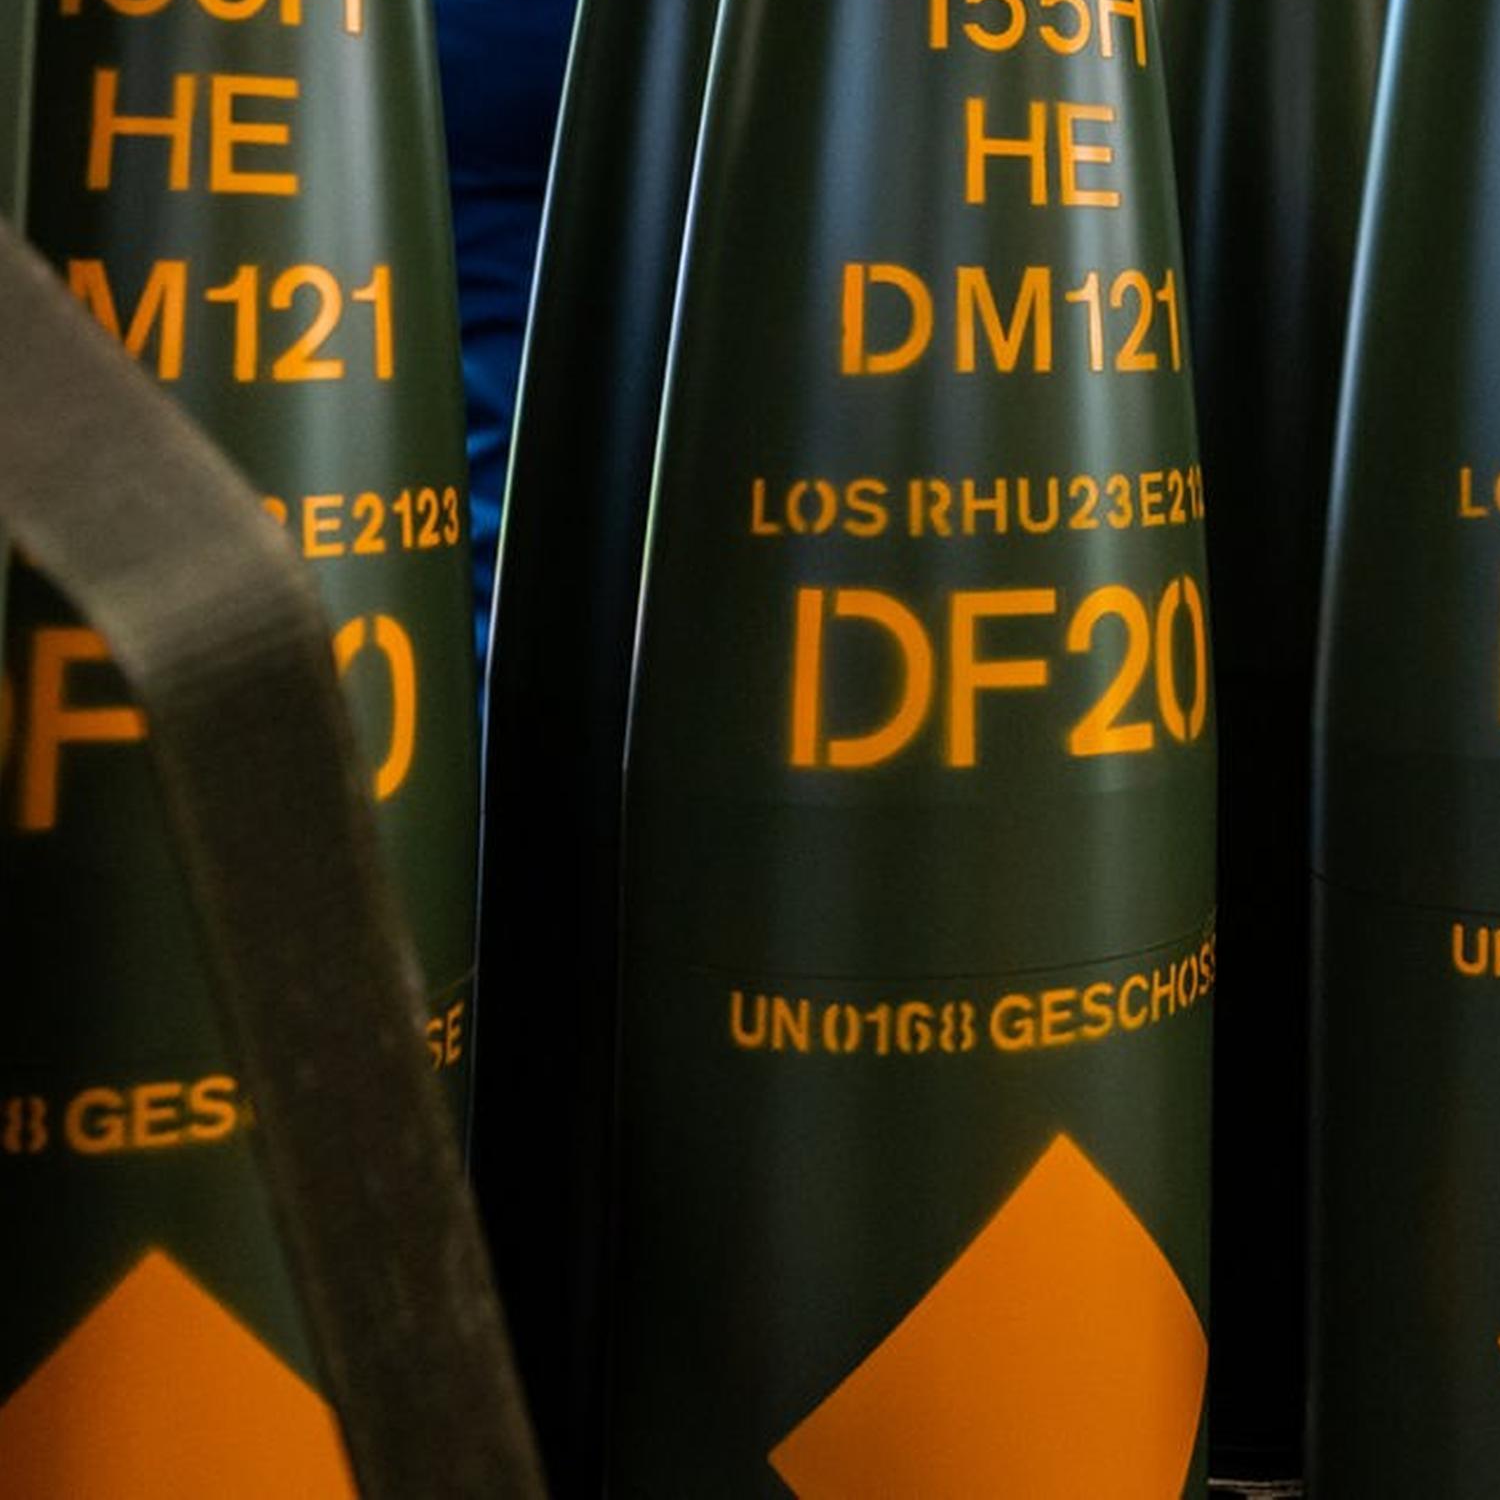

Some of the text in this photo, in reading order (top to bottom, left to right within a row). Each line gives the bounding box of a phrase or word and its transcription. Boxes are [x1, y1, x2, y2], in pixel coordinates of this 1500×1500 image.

[88, 68, 299, 194] HE
[966, 98, 1120, 207] HE
[66, 258, 393, 383] M121
[840, 263, 1181, 375] DM121
[258, 487, 459, 558] E2123
[750, 476, 890, 536] LOS
[789, 575, 1207, 769] DF20
[729, 992, 811, 1053] UN
[821, 1003, 978, 1055] 0168
